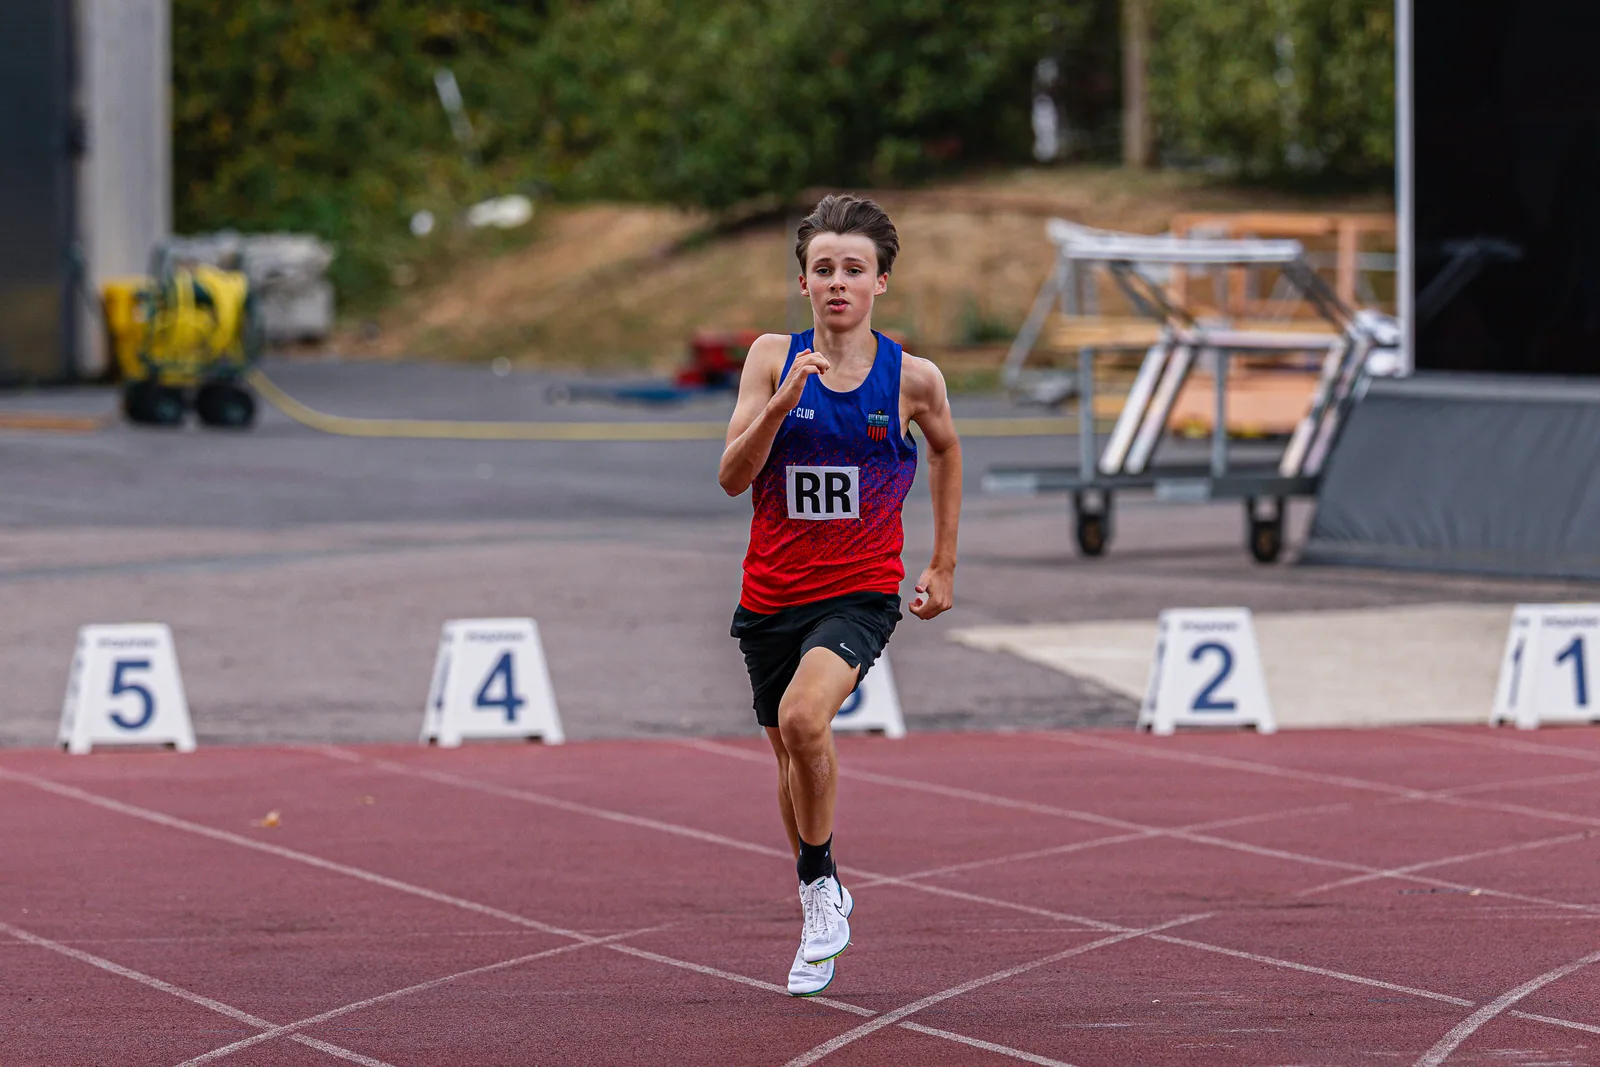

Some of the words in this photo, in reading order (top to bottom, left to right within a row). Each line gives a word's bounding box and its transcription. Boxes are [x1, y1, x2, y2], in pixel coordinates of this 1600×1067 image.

[795, 472, 852, 513] RR
[109, 659, 155, 730] 5
[474, 651, 525, 723] 4
[1190, 641, 1237, 712] 2
[1556, 636, 1588, 708] 1
